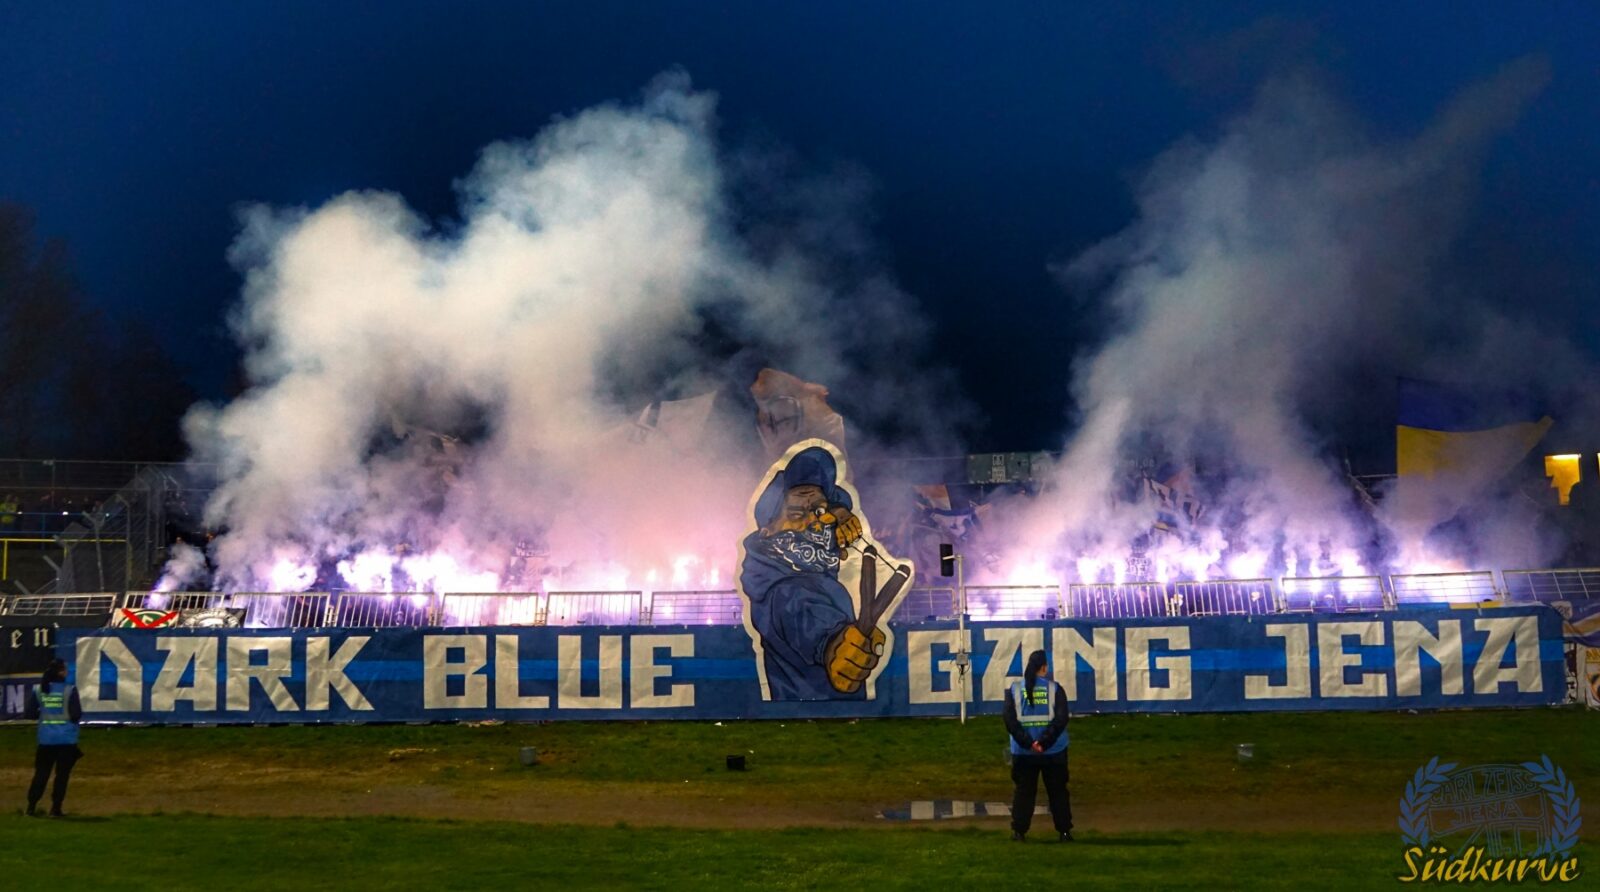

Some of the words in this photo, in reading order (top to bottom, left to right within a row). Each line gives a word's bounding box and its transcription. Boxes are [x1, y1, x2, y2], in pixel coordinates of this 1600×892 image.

[76, 636, 374, 712] DARK
[423, 634, 695, 709] BLUE
[907, 626, 1192, 705] GANG
[1245, 615, 1543, 699] JENA
